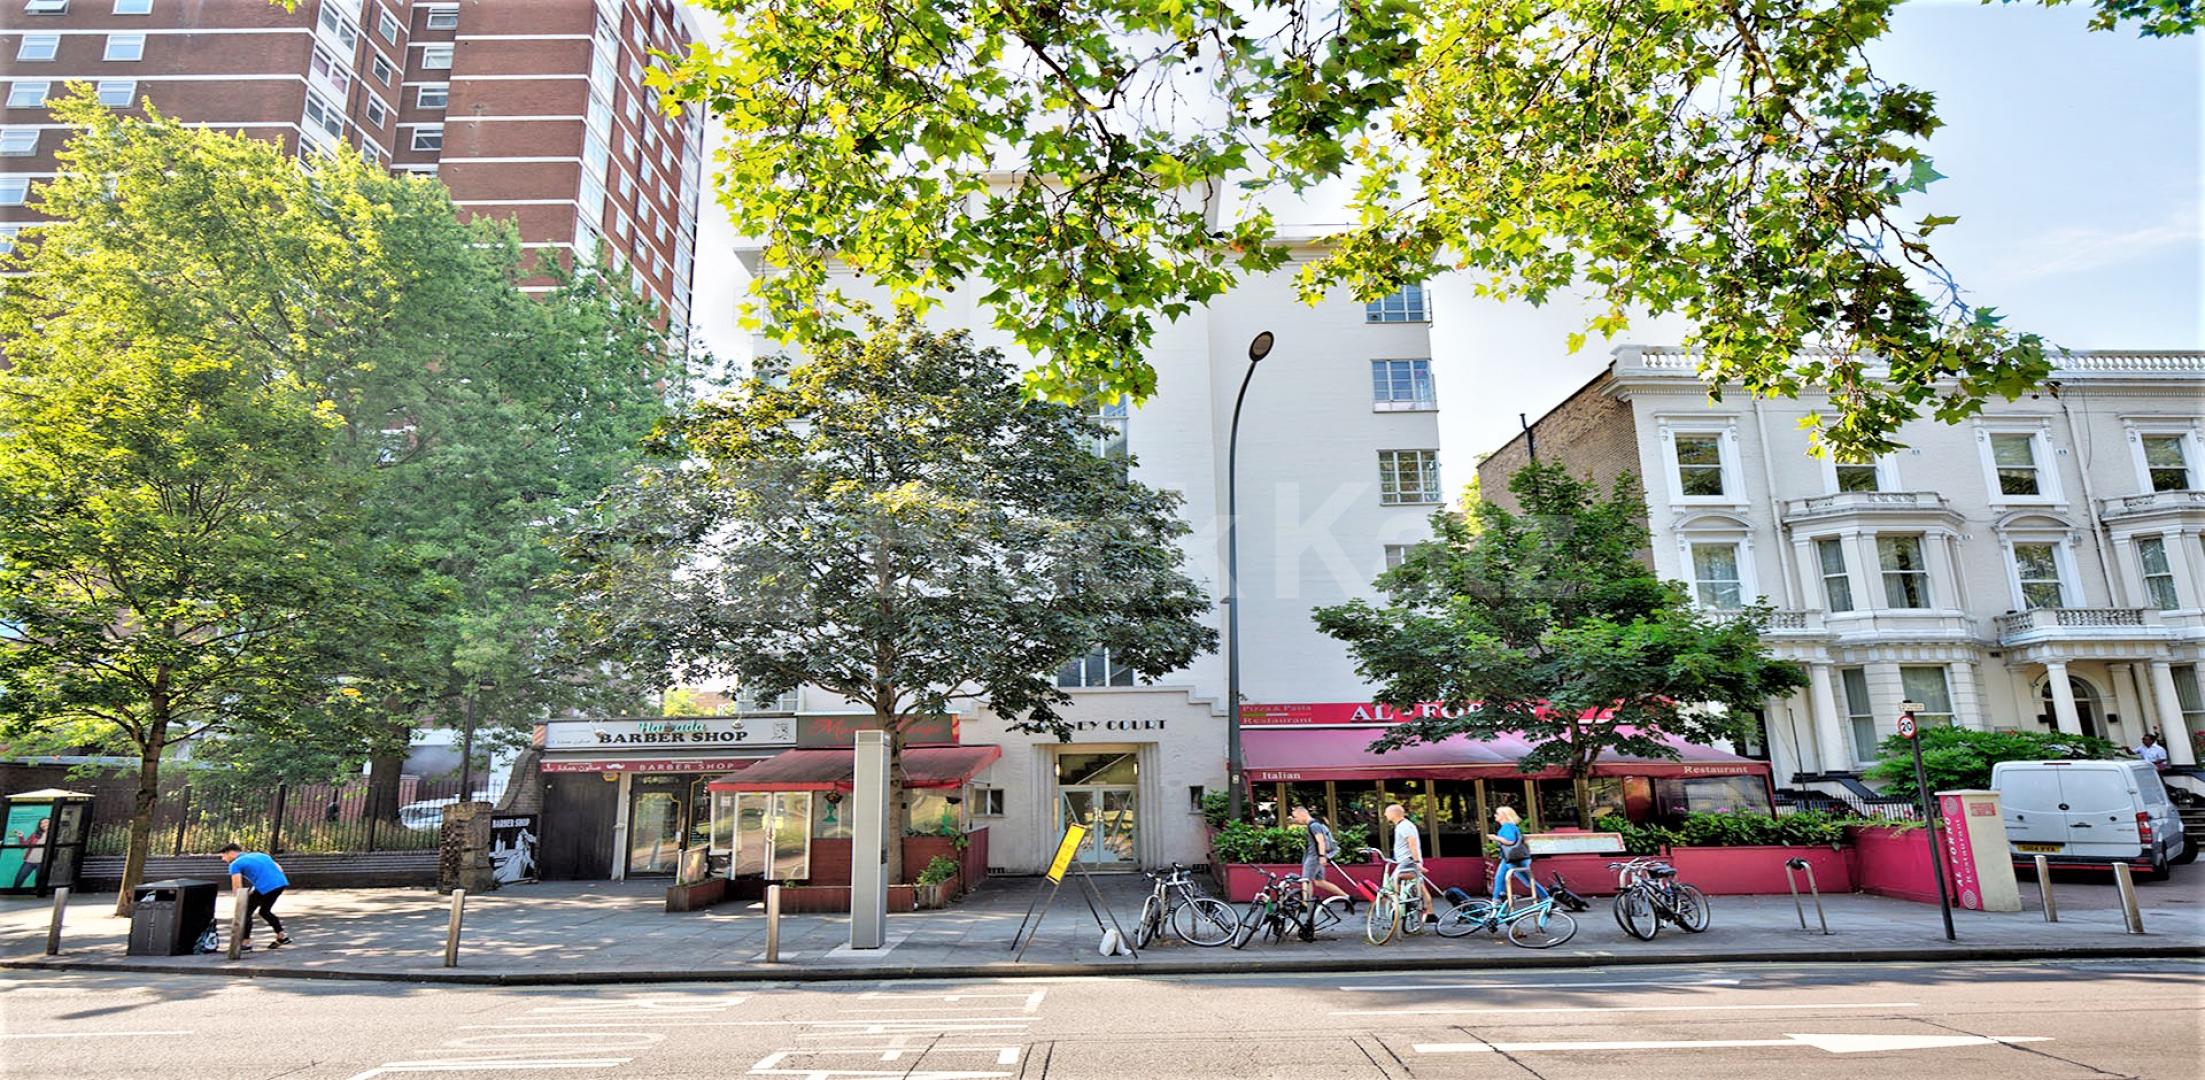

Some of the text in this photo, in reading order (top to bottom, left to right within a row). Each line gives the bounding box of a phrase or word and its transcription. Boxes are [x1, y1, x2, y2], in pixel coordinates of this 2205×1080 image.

[1351, 705, 1394, 721] AL
[1106, 719, 1167, 731] COURT
[1243, 717, 1313, 725] Restaurant
[1901, 721, 1912, 732] 20
[599, 732, 685, 744] BARBER
[691, 731, 748, 743] SHOP
[640, 762, 735, 771] BARBER SHOP
[1683, 765, 1749, 774] Restaurant
[1262, 771, 1301, 780] Italian
[1943, 816, 1959, 865] FORNO
